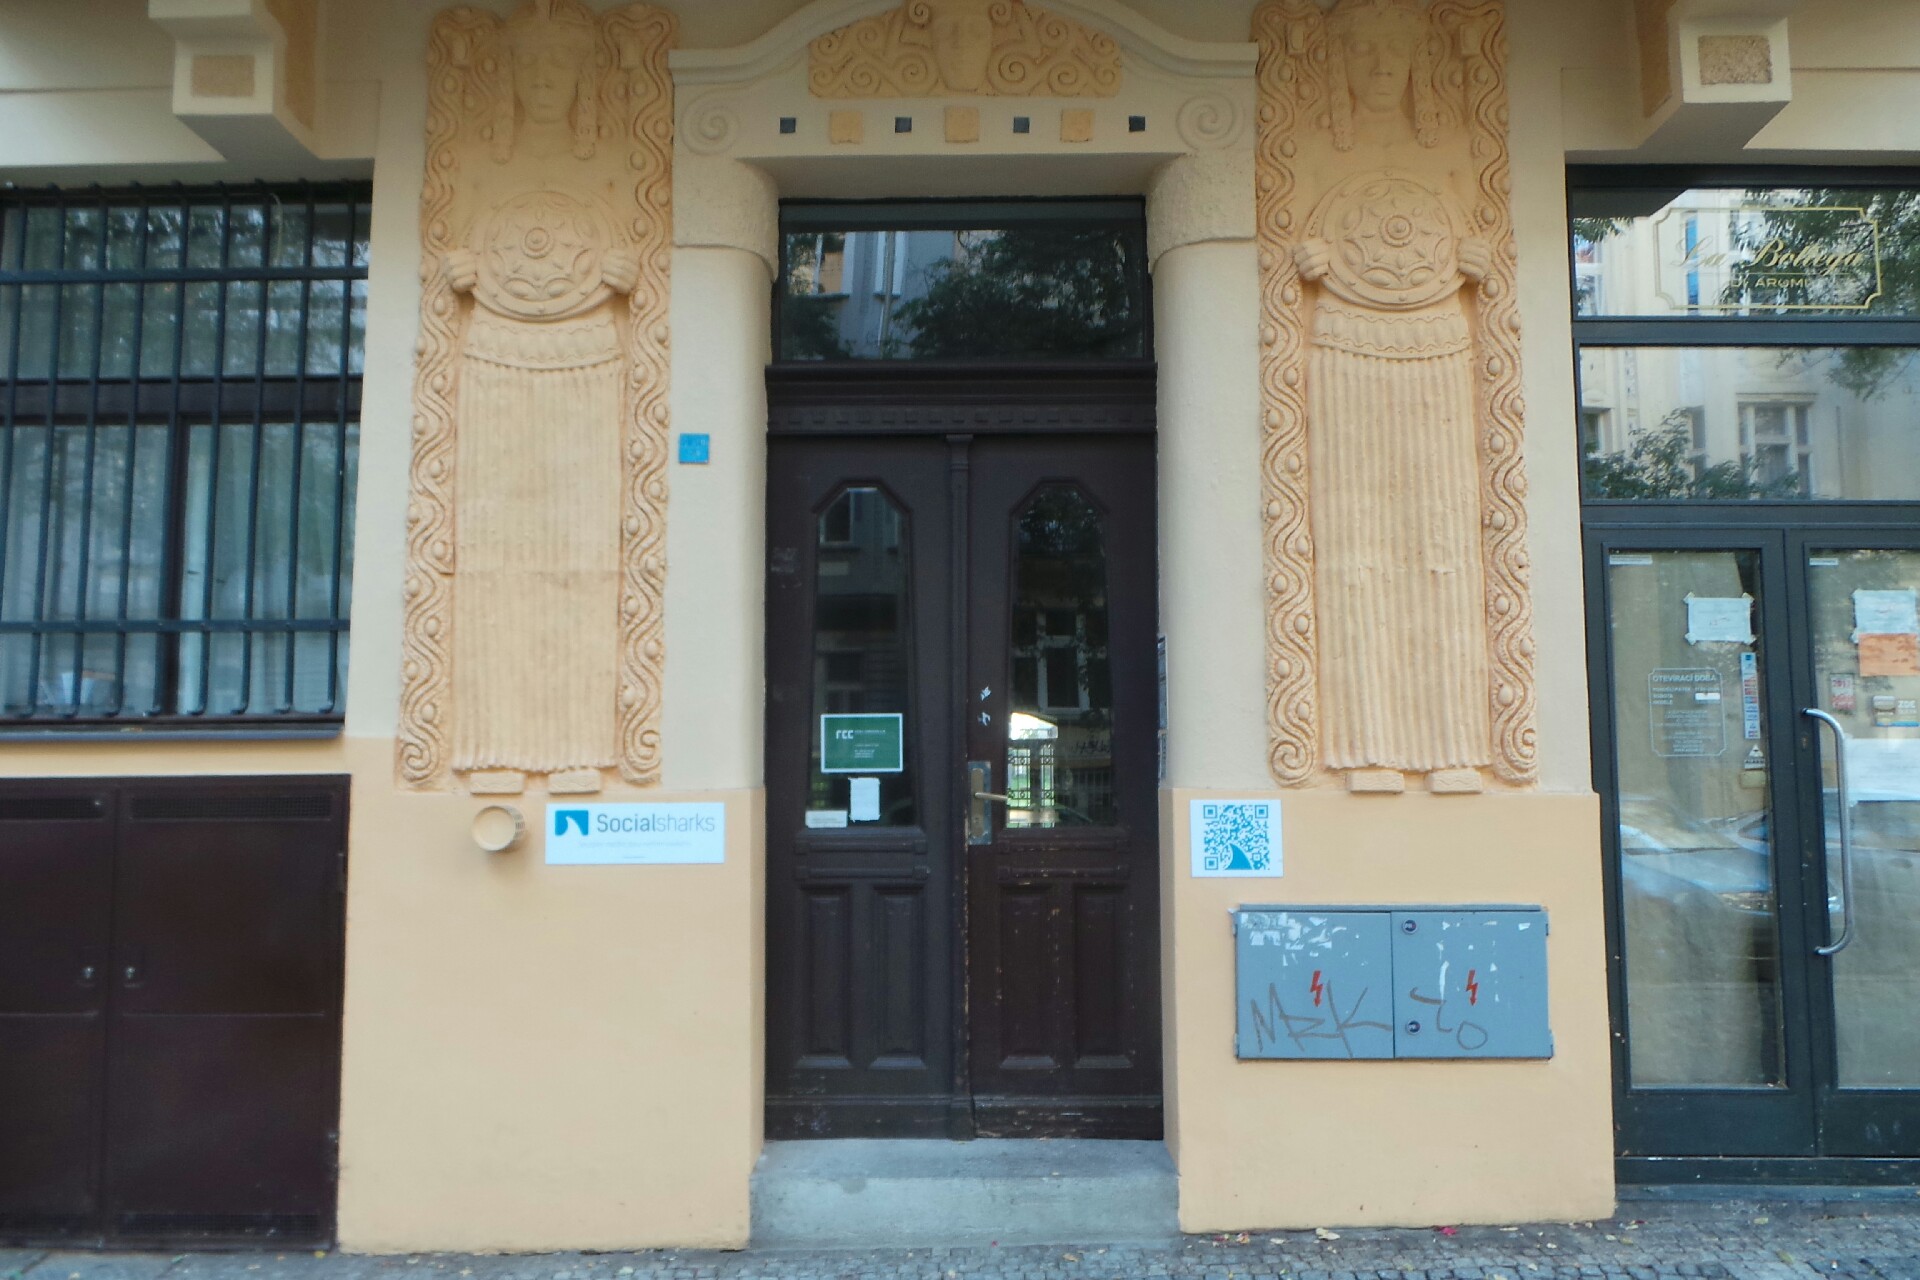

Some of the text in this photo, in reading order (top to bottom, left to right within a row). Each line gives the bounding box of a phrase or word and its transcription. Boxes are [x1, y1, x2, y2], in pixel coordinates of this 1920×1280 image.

[1671, 236, 1863, 276] La Bottega
[1755, 278, 1809, 288] AROMI
[596, 813, 716, 833] Socialsharks
